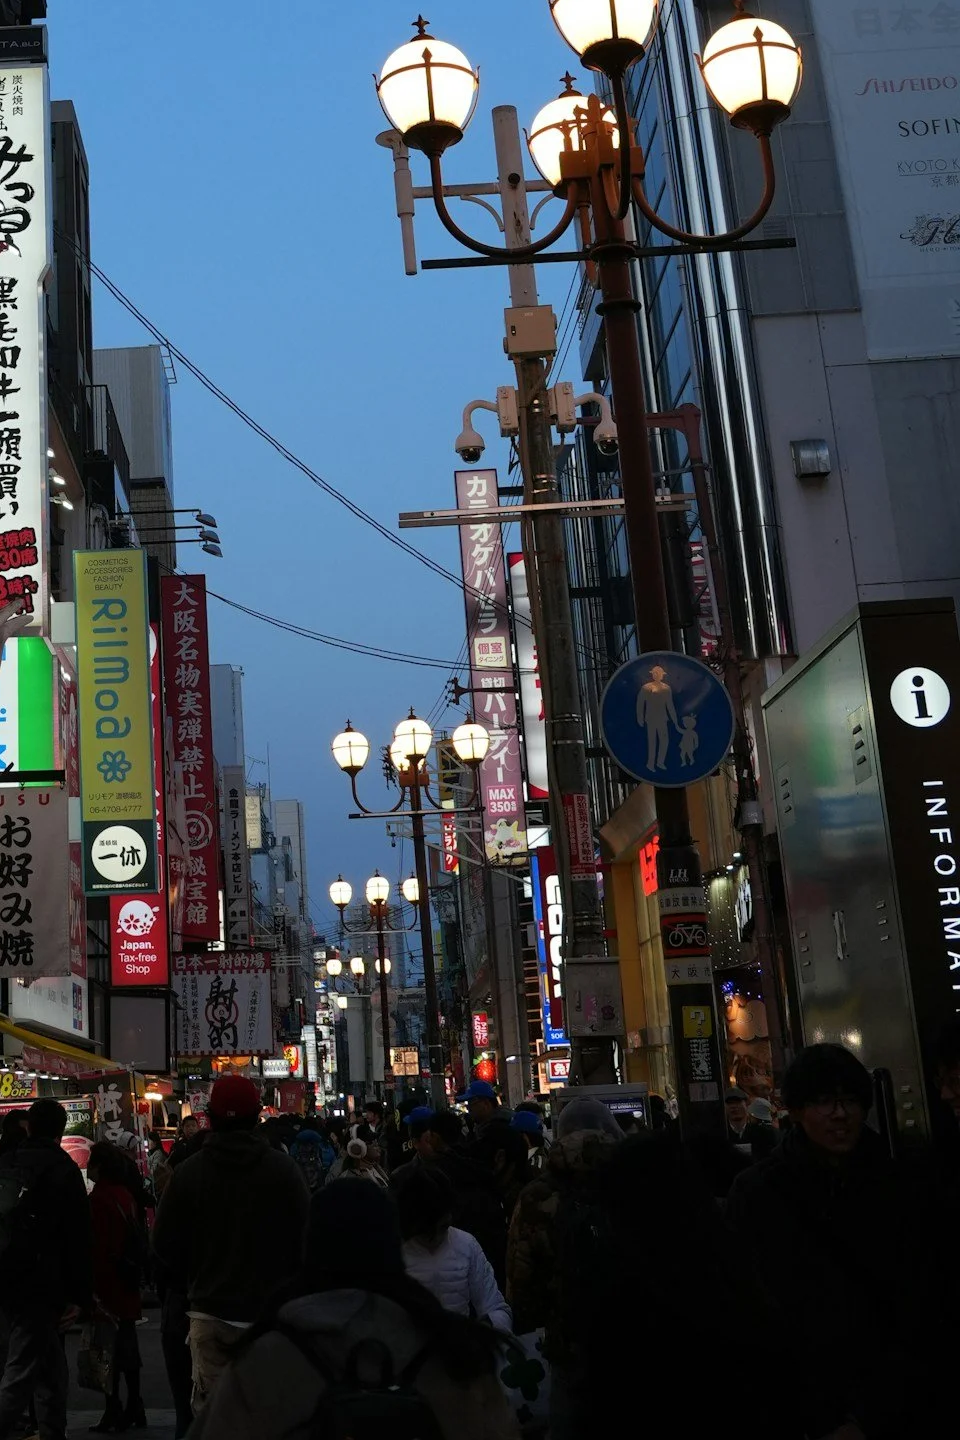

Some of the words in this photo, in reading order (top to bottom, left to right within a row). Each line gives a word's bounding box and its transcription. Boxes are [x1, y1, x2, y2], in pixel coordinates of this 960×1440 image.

[855, 75, 958, 97] SHISEIDO
[897, 158, 947, 175] KYOTO
[87, 558, 129, 567] COSMETICS
[83, 566, 133, 575] ACCESSORIES
[93, 575, 125, 583] FASHION
[94, 583, 123, 591] BEAUTY
[478, 642, 504, 654] 個室
[172, 581, 208, 801] 大阪名物実弾禁止
[488, 787, 516, 800] MAX
[98, 846, 141, 867] 一休
[120, 940, 155, 951] Japan.
[118, 952, 157, 963] Tax-free
[174, 950, 266, 971] 日本一射的場
[125, 964, 150, 976] Shop
[206, 975, 239, 1050] 射的
[10, 1088, 33, 1098] OFF
